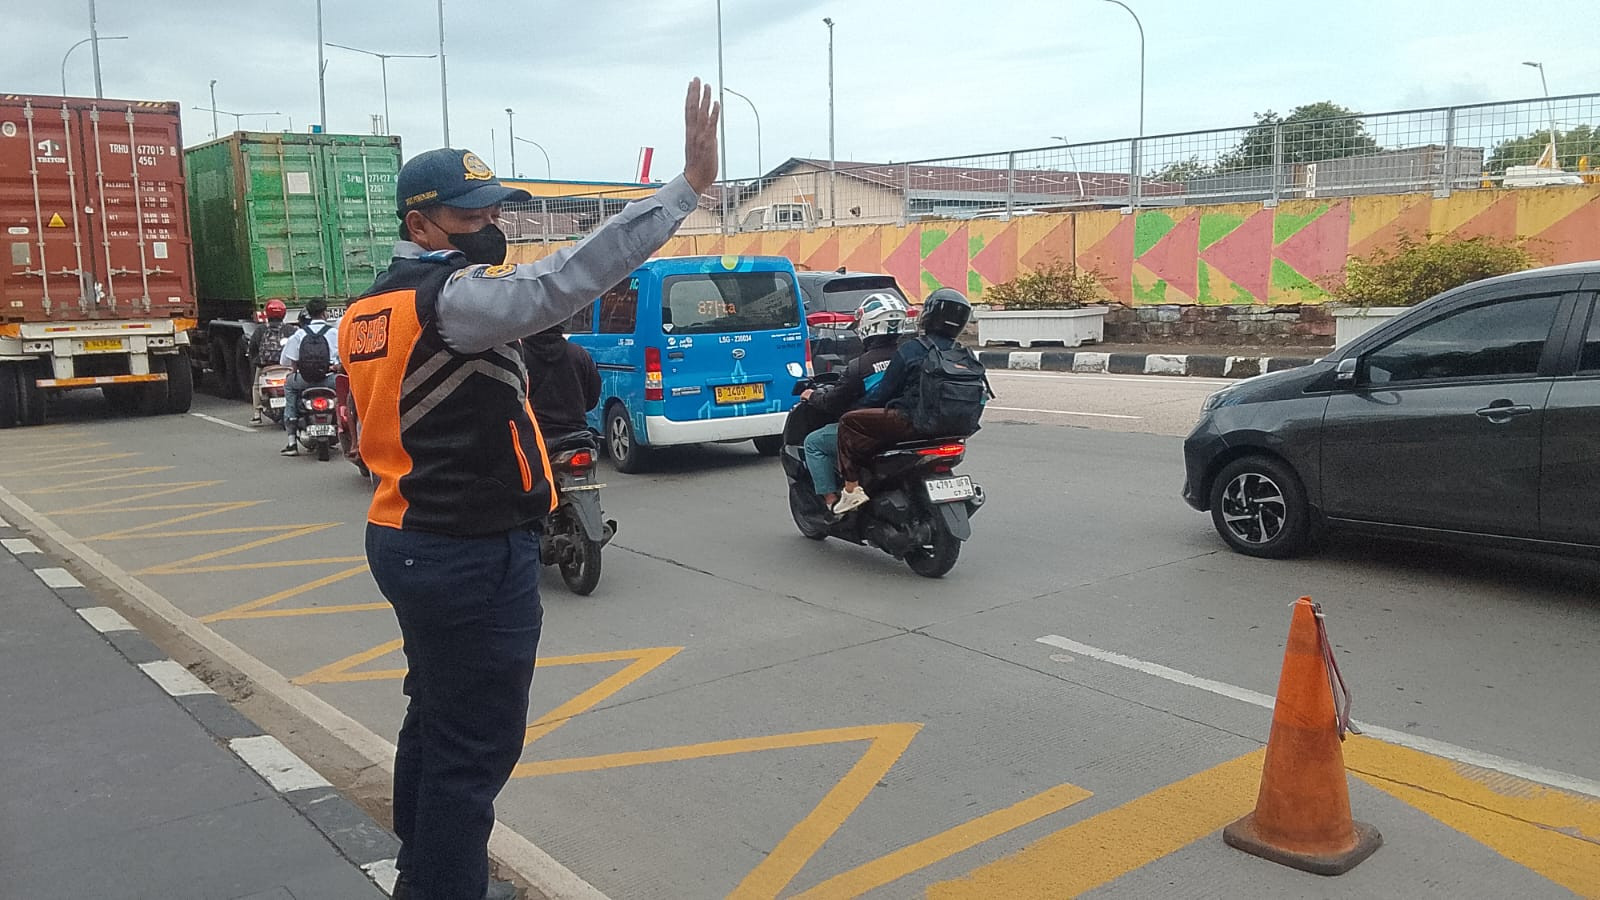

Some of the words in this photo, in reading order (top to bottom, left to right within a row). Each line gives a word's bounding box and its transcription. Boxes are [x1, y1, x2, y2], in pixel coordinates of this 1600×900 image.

[109, 143, 129, 154] TRHU
[137, 144, 165, 155] 677015
[717, 388, 722, 398] B
